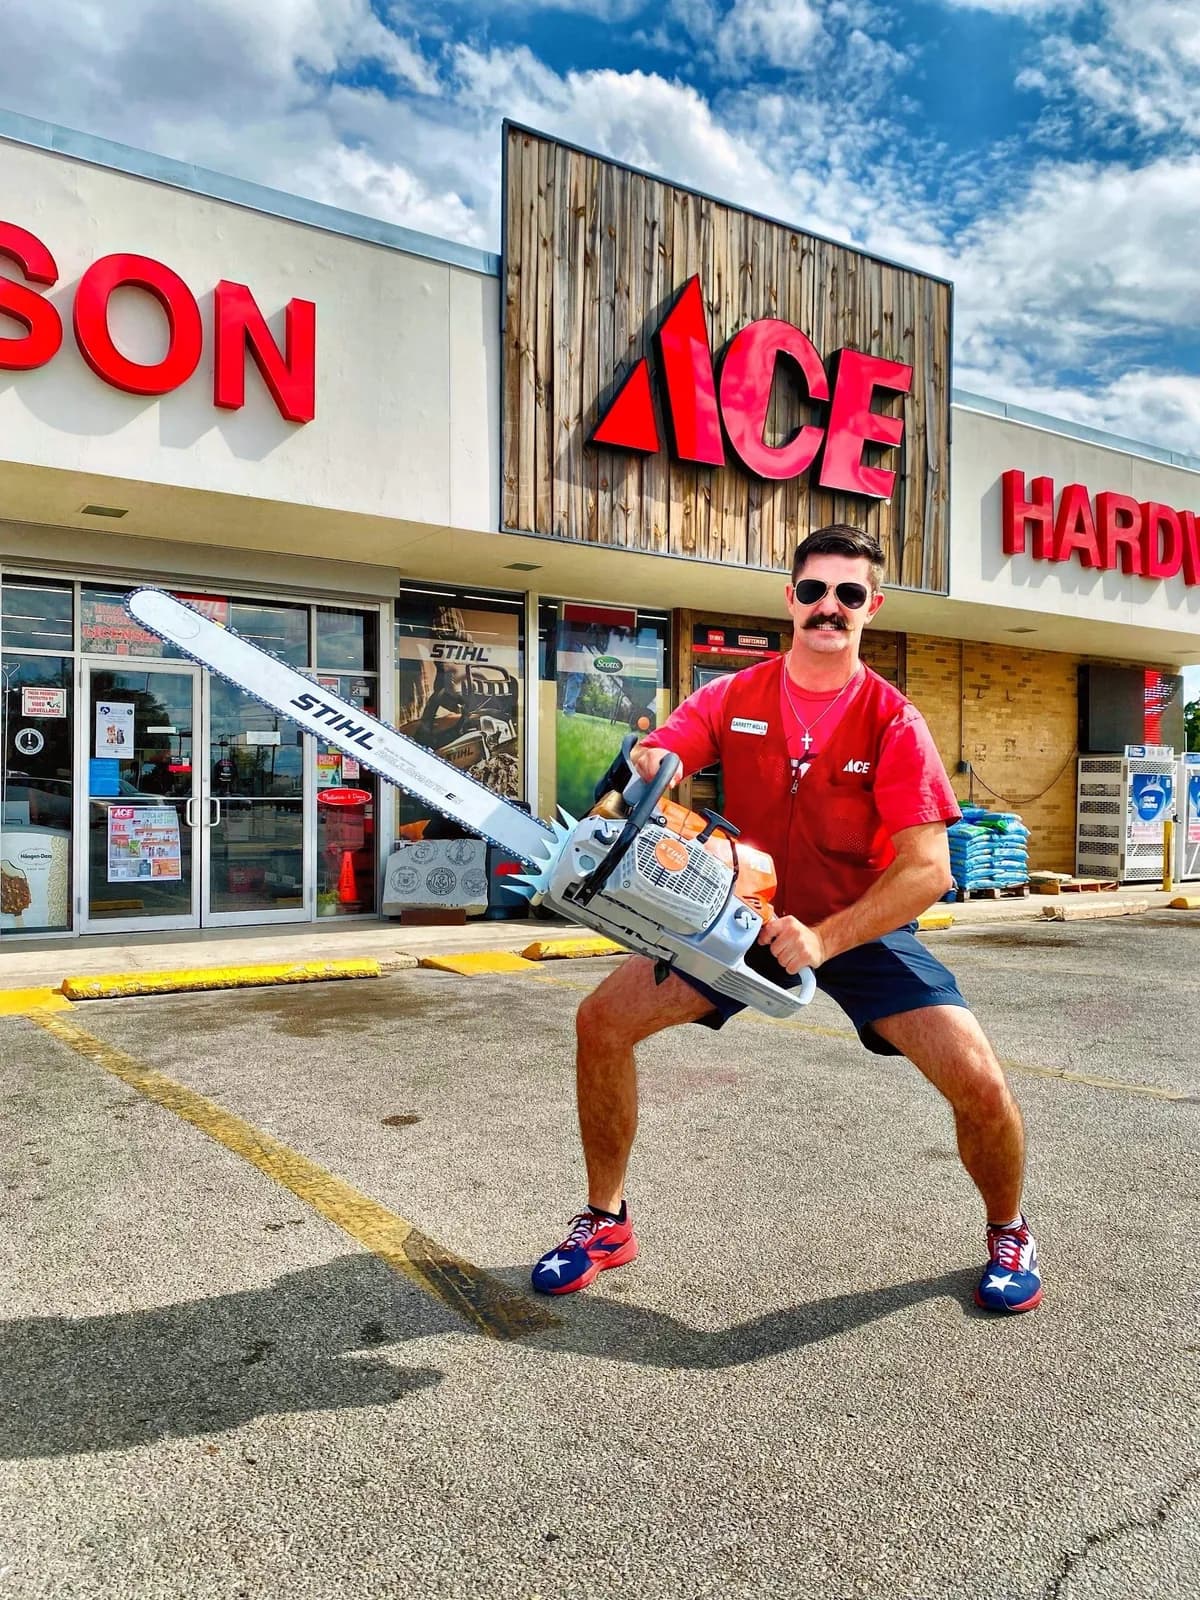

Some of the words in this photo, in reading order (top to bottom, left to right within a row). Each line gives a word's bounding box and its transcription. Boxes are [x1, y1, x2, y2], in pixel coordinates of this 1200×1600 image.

[593, 273, 914, 499] ACE
[1002, 469, 1200, 586] HARD
[430, 643, 489, 662] STIHL
[597, 659, 620, 669] Scotts
[290, 692, 376, 751] STIHL
[842, 758, 871, 774] ACE
[114, 808, 134, 817] ACE
[660, 842, 687, 865] STIHL
